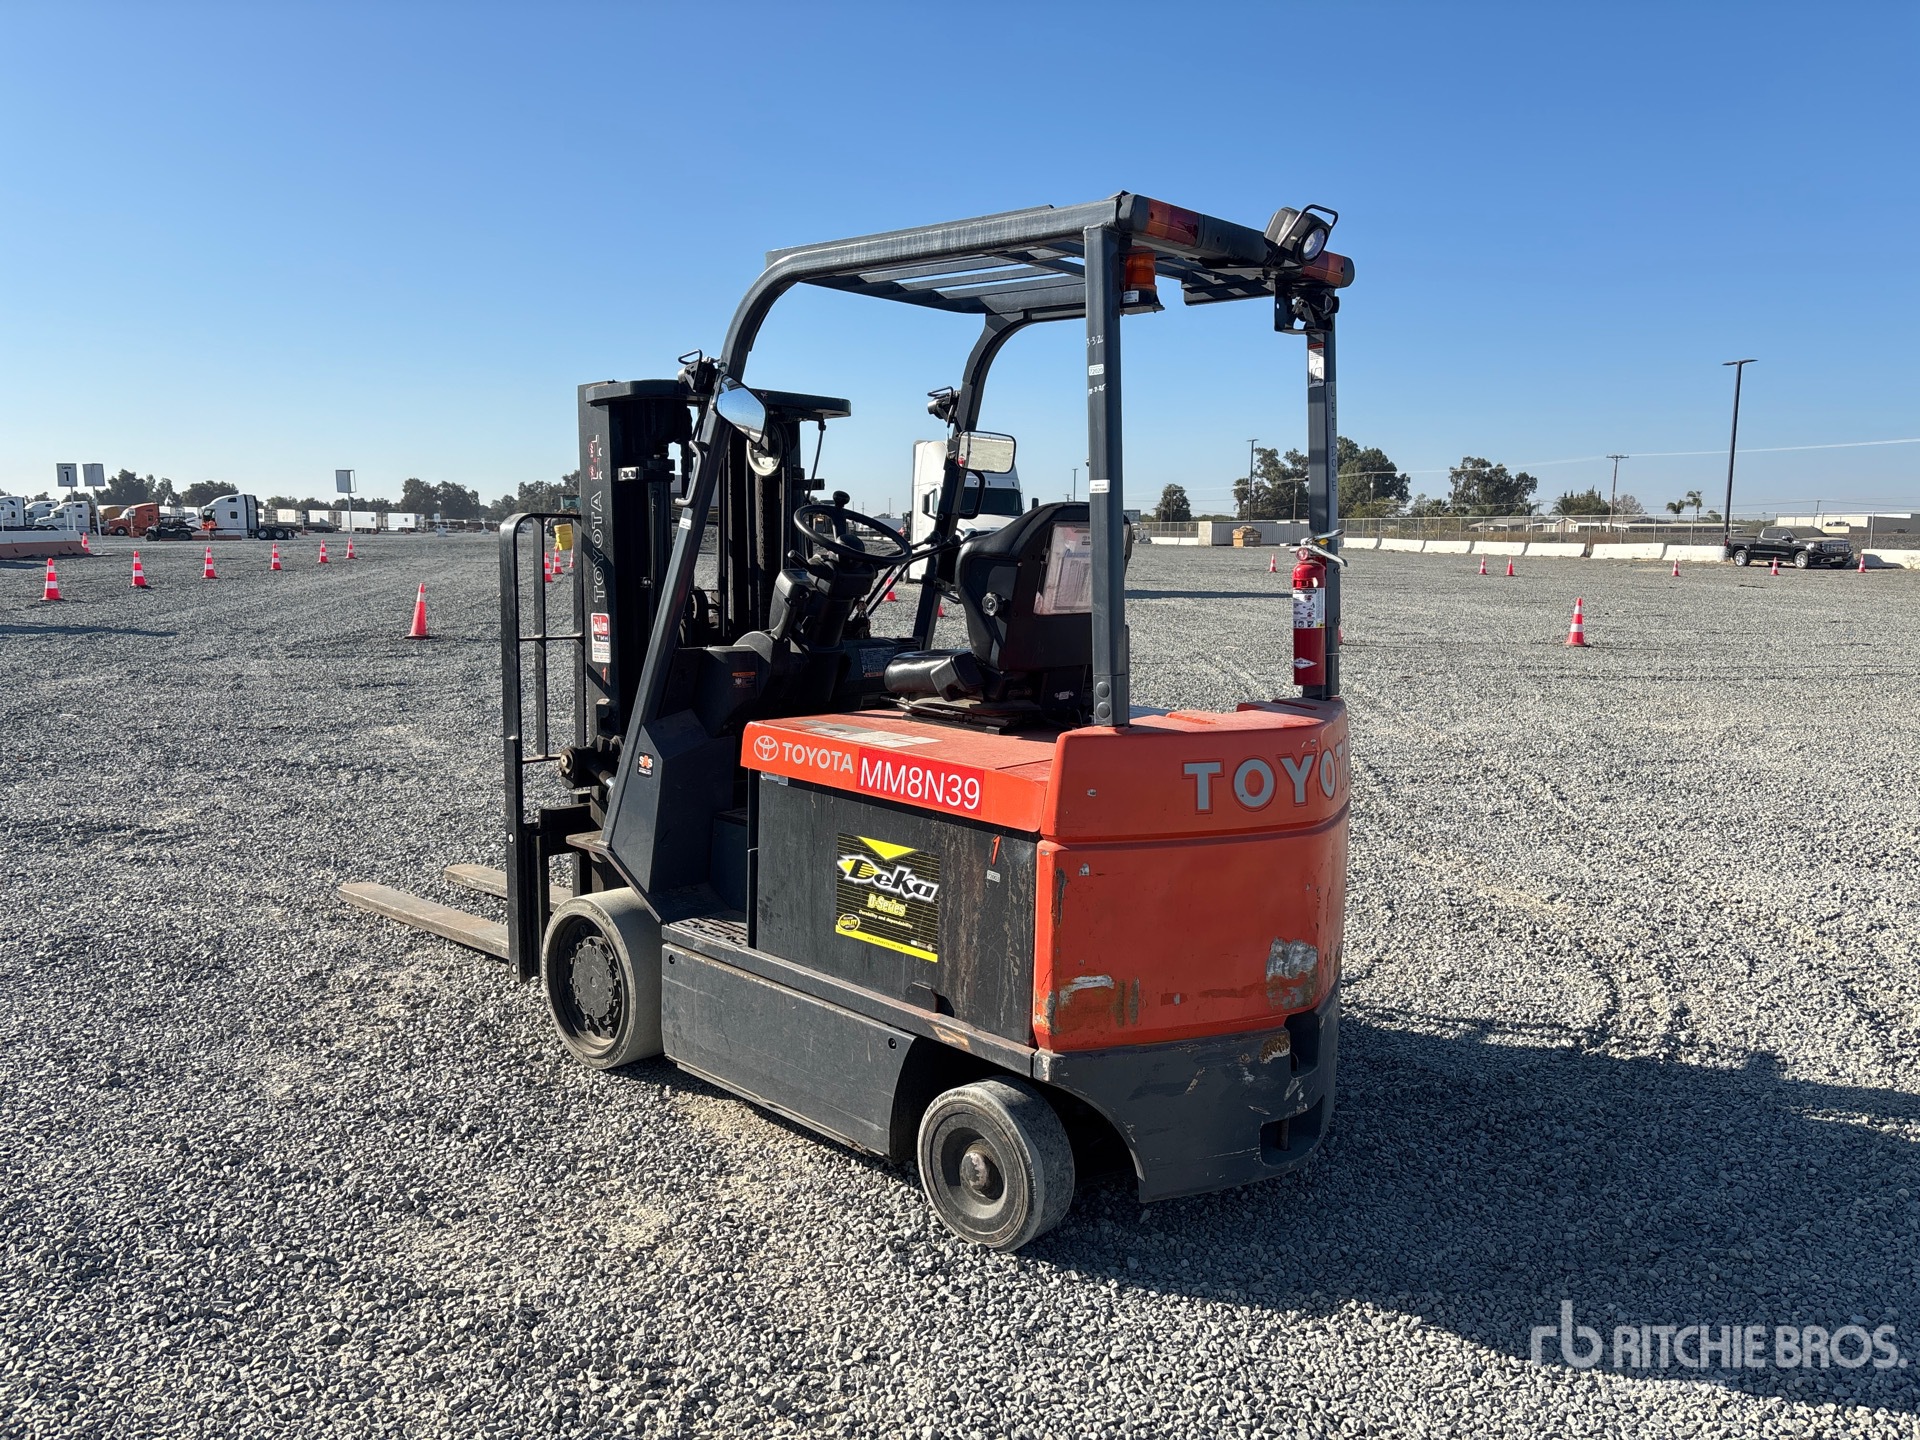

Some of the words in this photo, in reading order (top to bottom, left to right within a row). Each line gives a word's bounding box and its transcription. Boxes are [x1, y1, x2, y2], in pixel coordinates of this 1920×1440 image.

[64, 471, 69, 482] 1
[590, 490, 607, 603] TOYOTA
[782, 742, 854, 774] TOYOTA
[860, 757, 980, 810] MM8N39
[839, 855, 938, 901] Deka
[858, 909, 878, 920] Durability
[886, 917, 913, 930] dependability
[866, 893, 906, 916] D-Series
